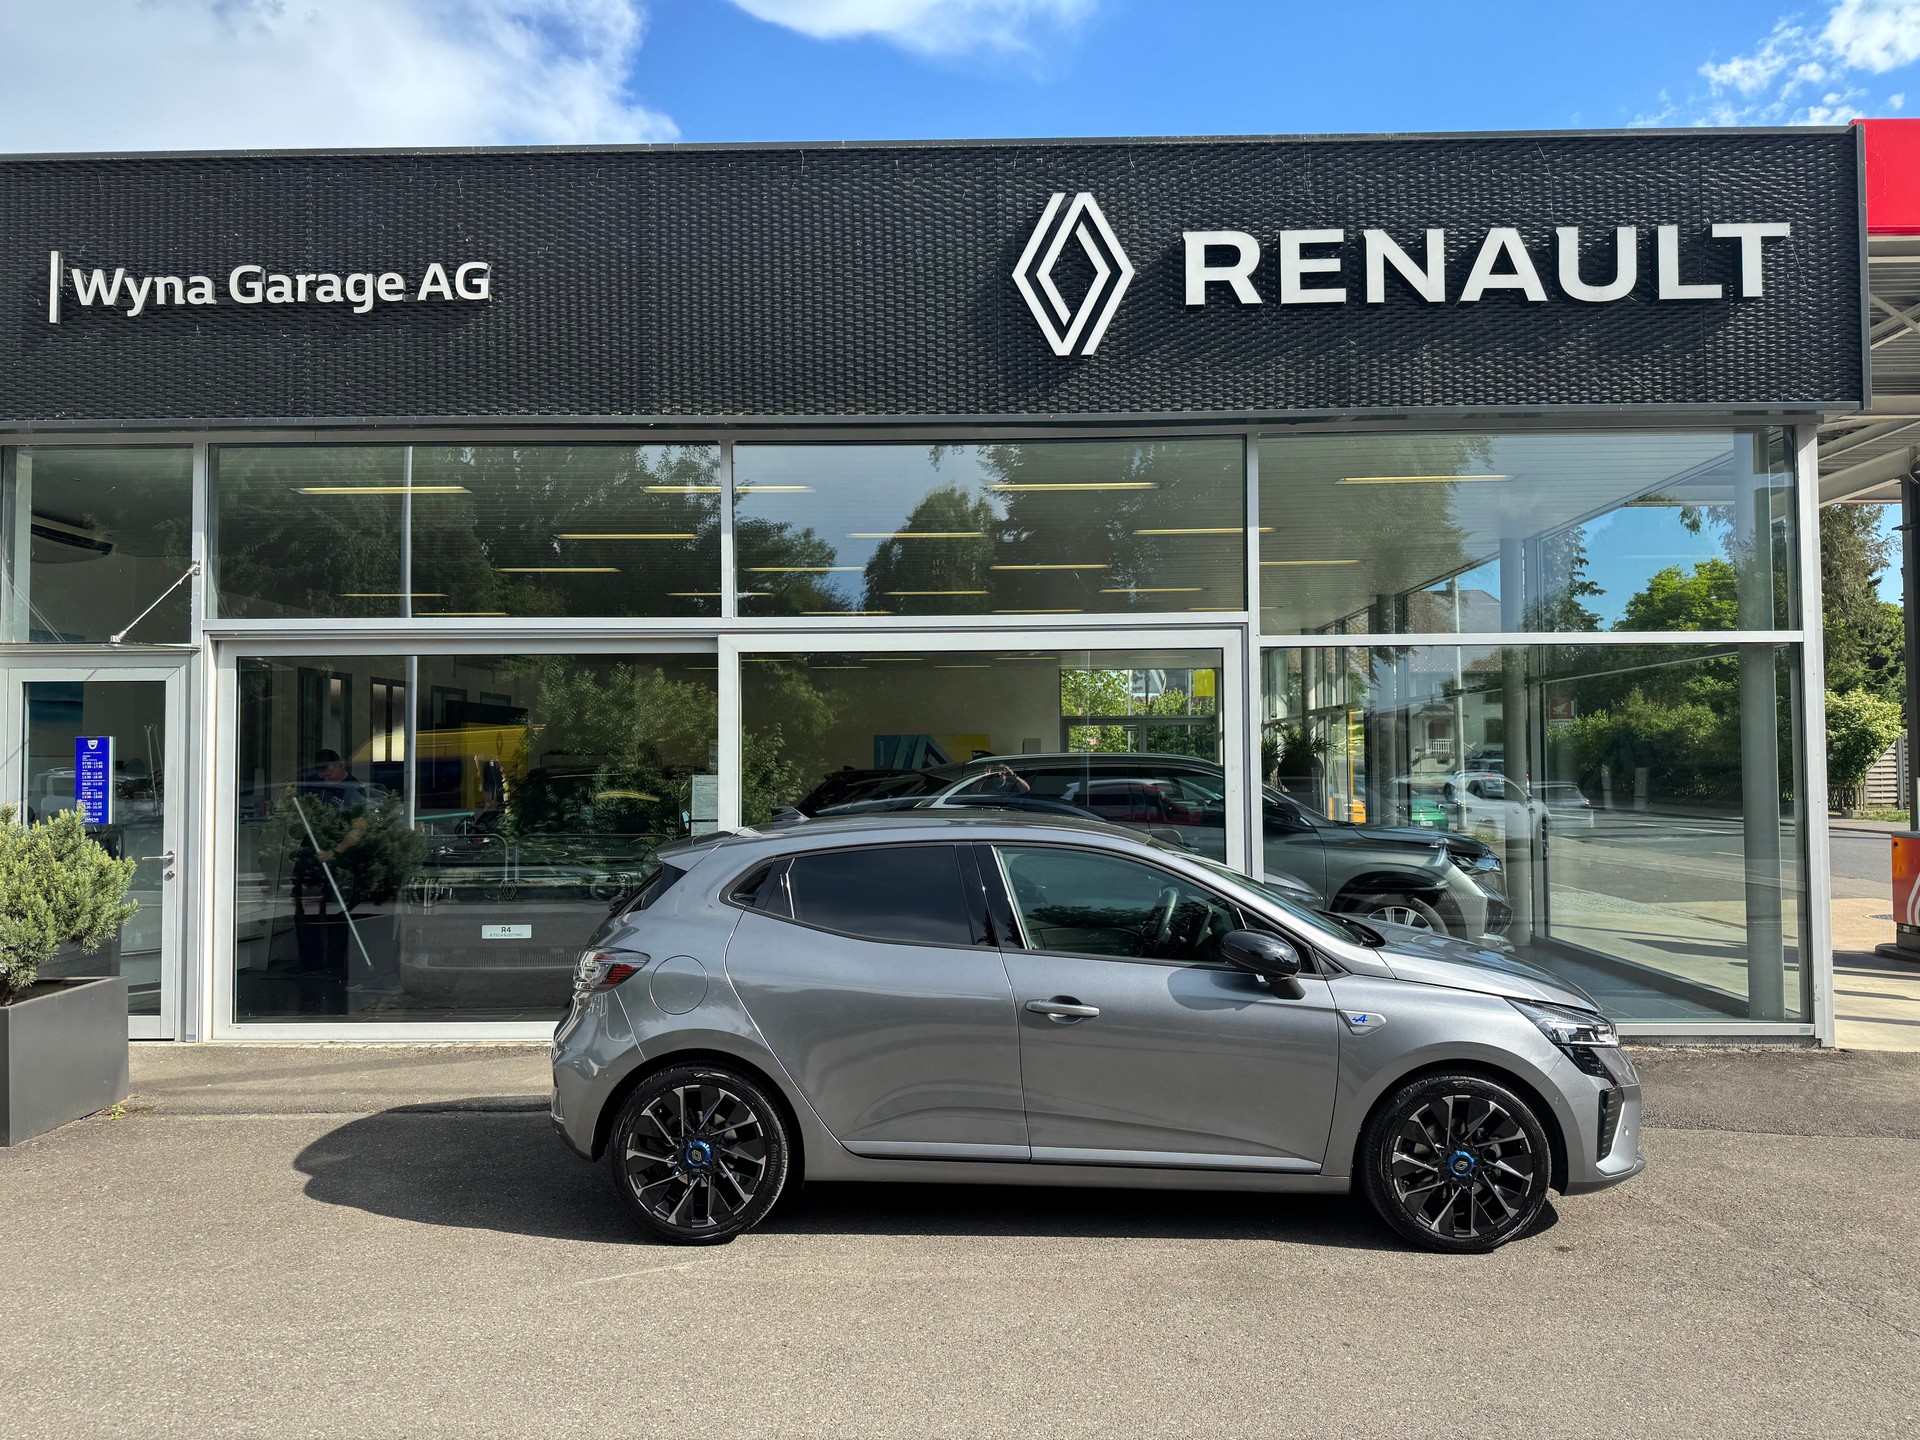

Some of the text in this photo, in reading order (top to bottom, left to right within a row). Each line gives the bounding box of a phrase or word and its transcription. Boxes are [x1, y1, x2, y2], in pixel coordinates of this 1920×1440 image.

[71, 261, 492, 317] Wyna Garage AG
[1183, 222, 1791, 306] RENAULT
